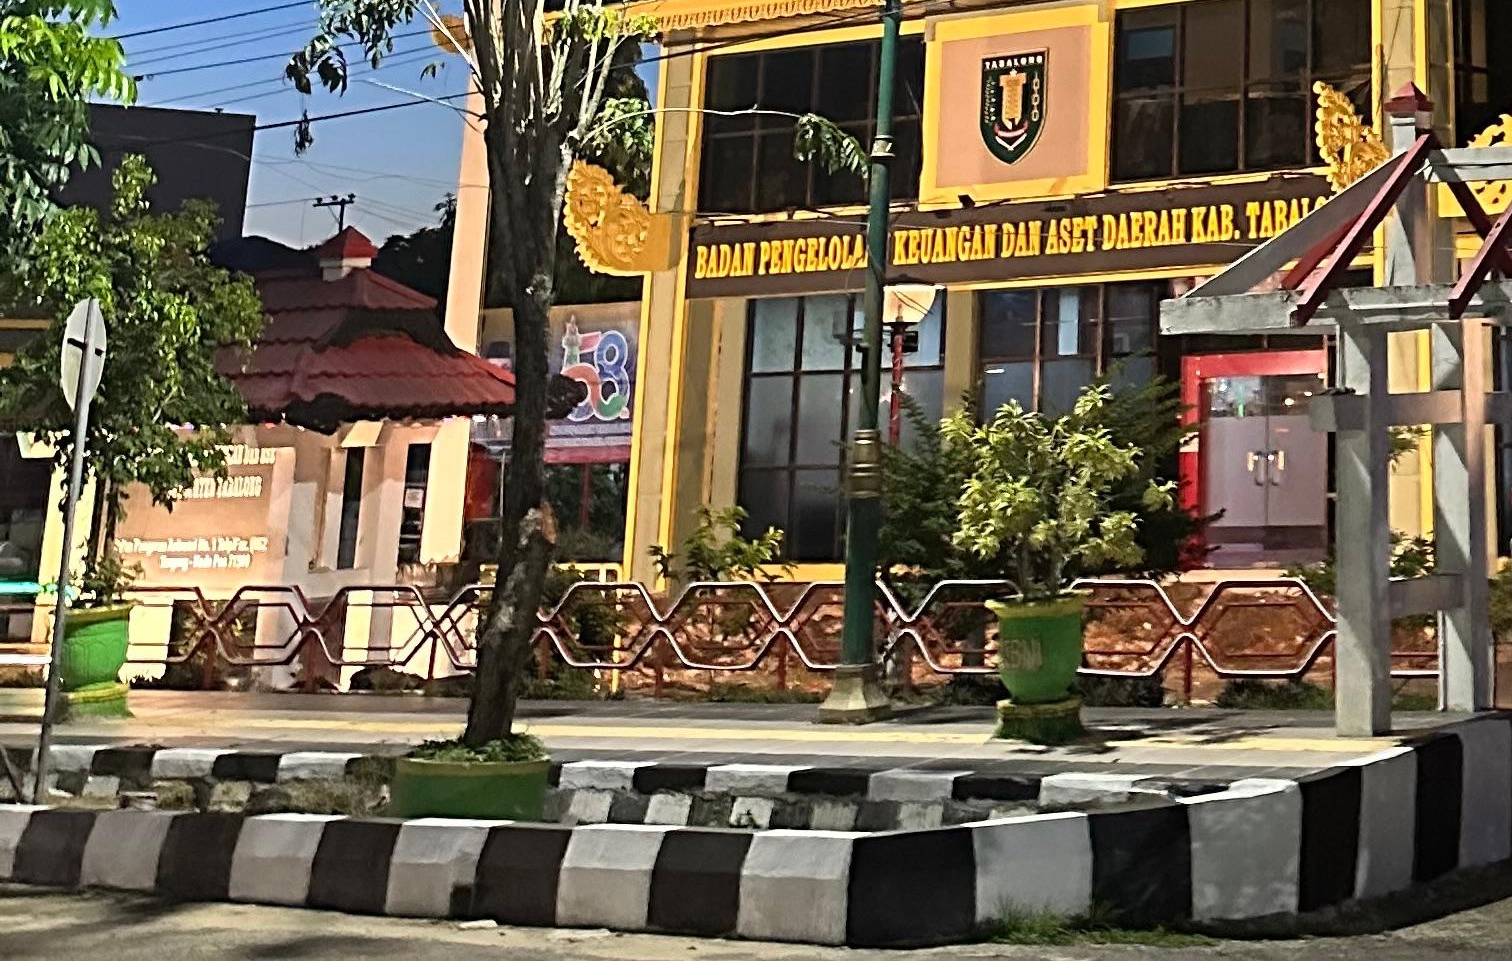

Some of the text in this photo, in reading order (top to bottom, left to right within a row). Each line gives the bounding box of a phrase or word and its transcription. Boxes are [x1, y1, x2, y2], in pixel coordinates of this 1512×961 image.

[985, 55, 1043, 70] TABALONG
[695, 195, 1327, 279] BADAN PENGELOLA KEUANGAN DAN ASET DAERAH KAB. TABAL
